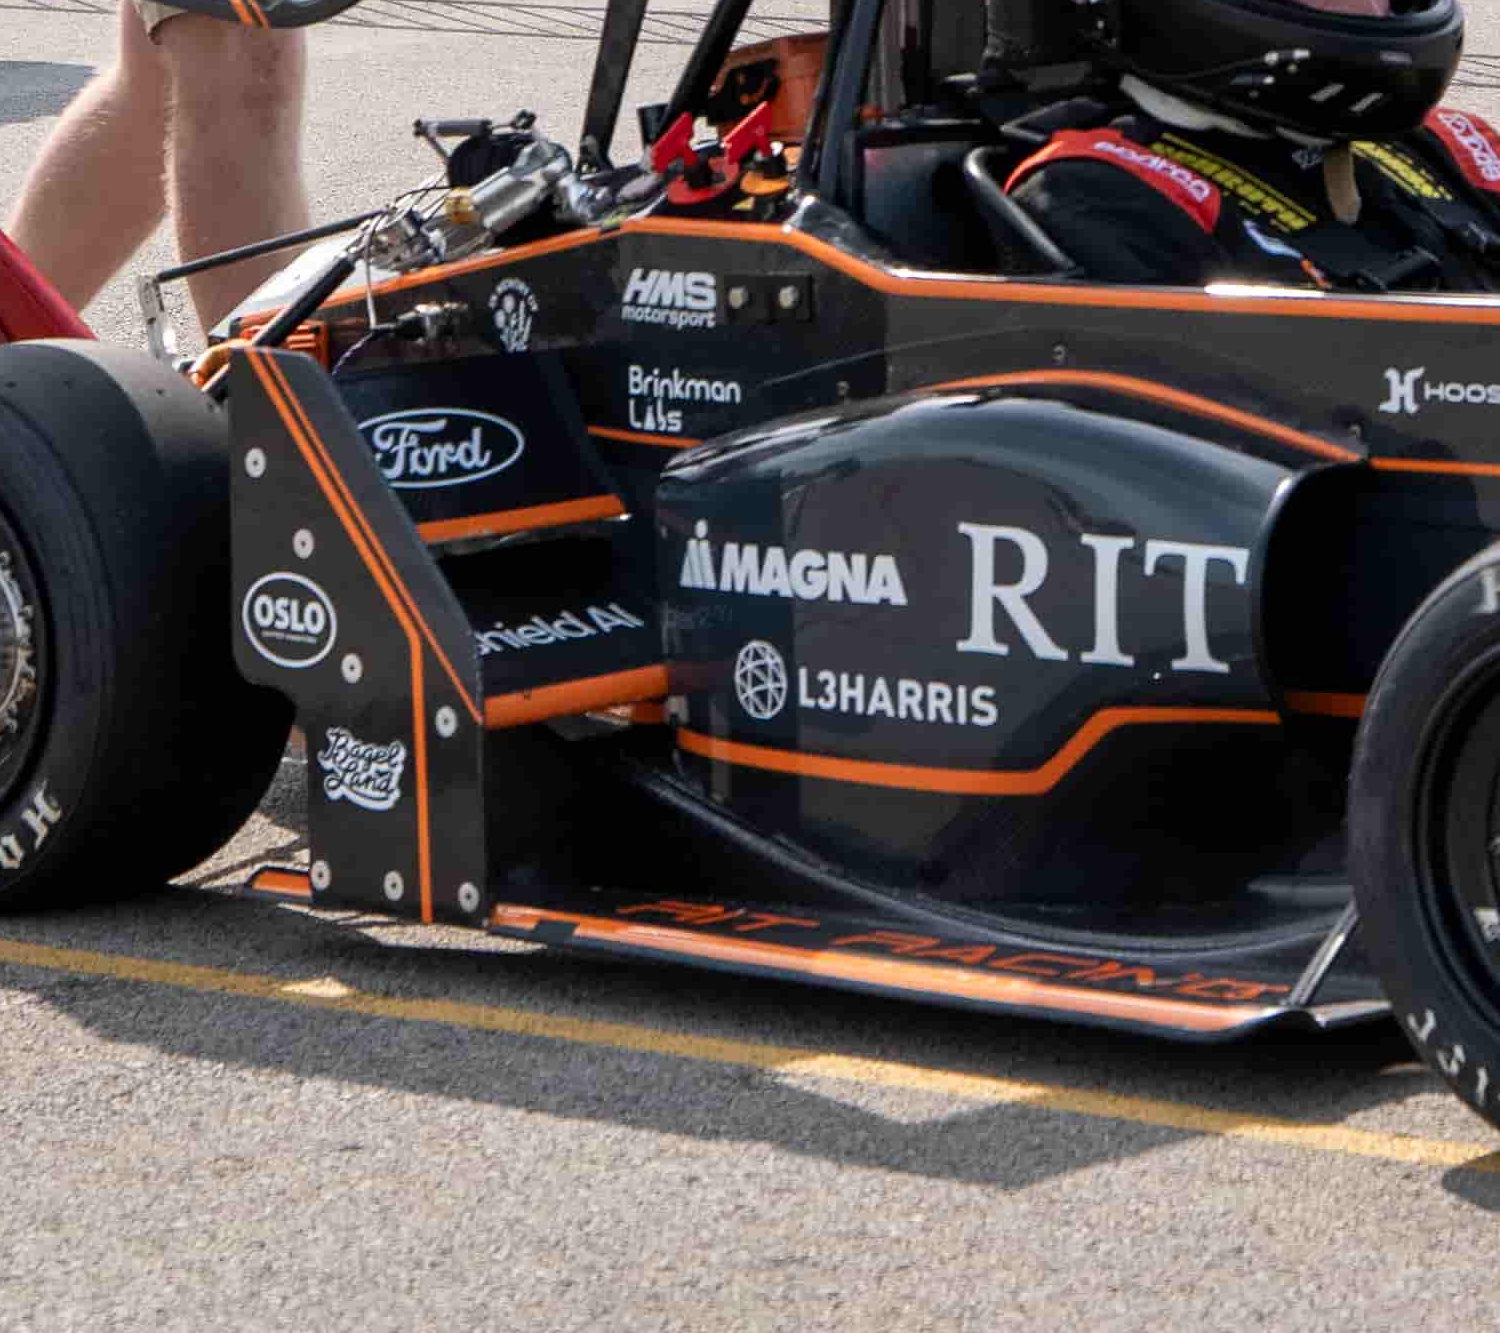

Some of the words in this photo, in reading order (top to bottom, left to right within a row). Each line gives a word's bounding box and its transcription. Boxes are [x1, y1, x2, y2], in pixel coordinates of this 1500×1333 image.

[623, 267, 717, 310] HMS
[621, 305, 717, 328] motorsport
[628, 364, 740, 403] Brinkman
[372, 419, 493, 479] Ford
[720, 542, 908, 607] MAGNA
[957, 521, 1250, 674] RIT
[253, 593, 326, 634] OSLO
[798, 667, 999, 726] L3HARRIS
[323, 725, 405, 774] Bagel
[325, 765, 400, 795] Land
